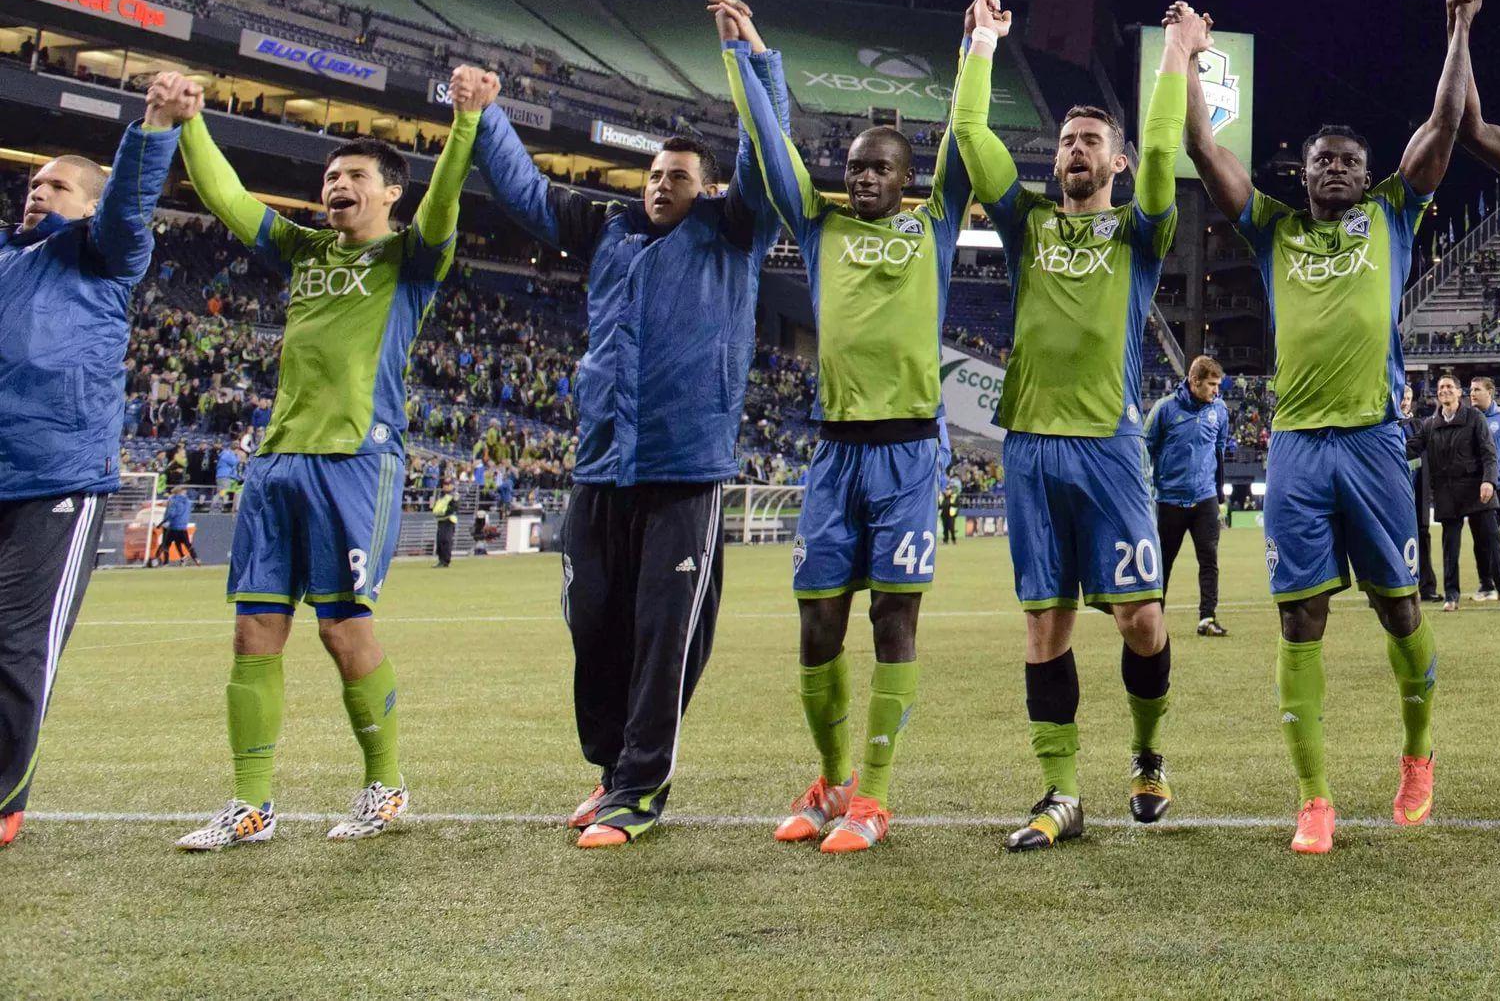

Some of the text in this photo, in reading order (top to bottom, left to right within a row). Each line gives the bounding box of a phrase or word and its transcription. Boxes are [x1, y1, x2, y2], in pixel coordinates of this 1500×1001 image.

[256, 39, 376, 79] BUD LIGHT
[801, 70, 1016, 104] XBOX OE
[602, 125, 664, 151] HomeStree
[1030, 242, 1113, 275] XBOX
[1286, 243, 1378, 281] XBOX
[893, 530, 935, 574] 42
[1114, 539, 1158, 586] 20
